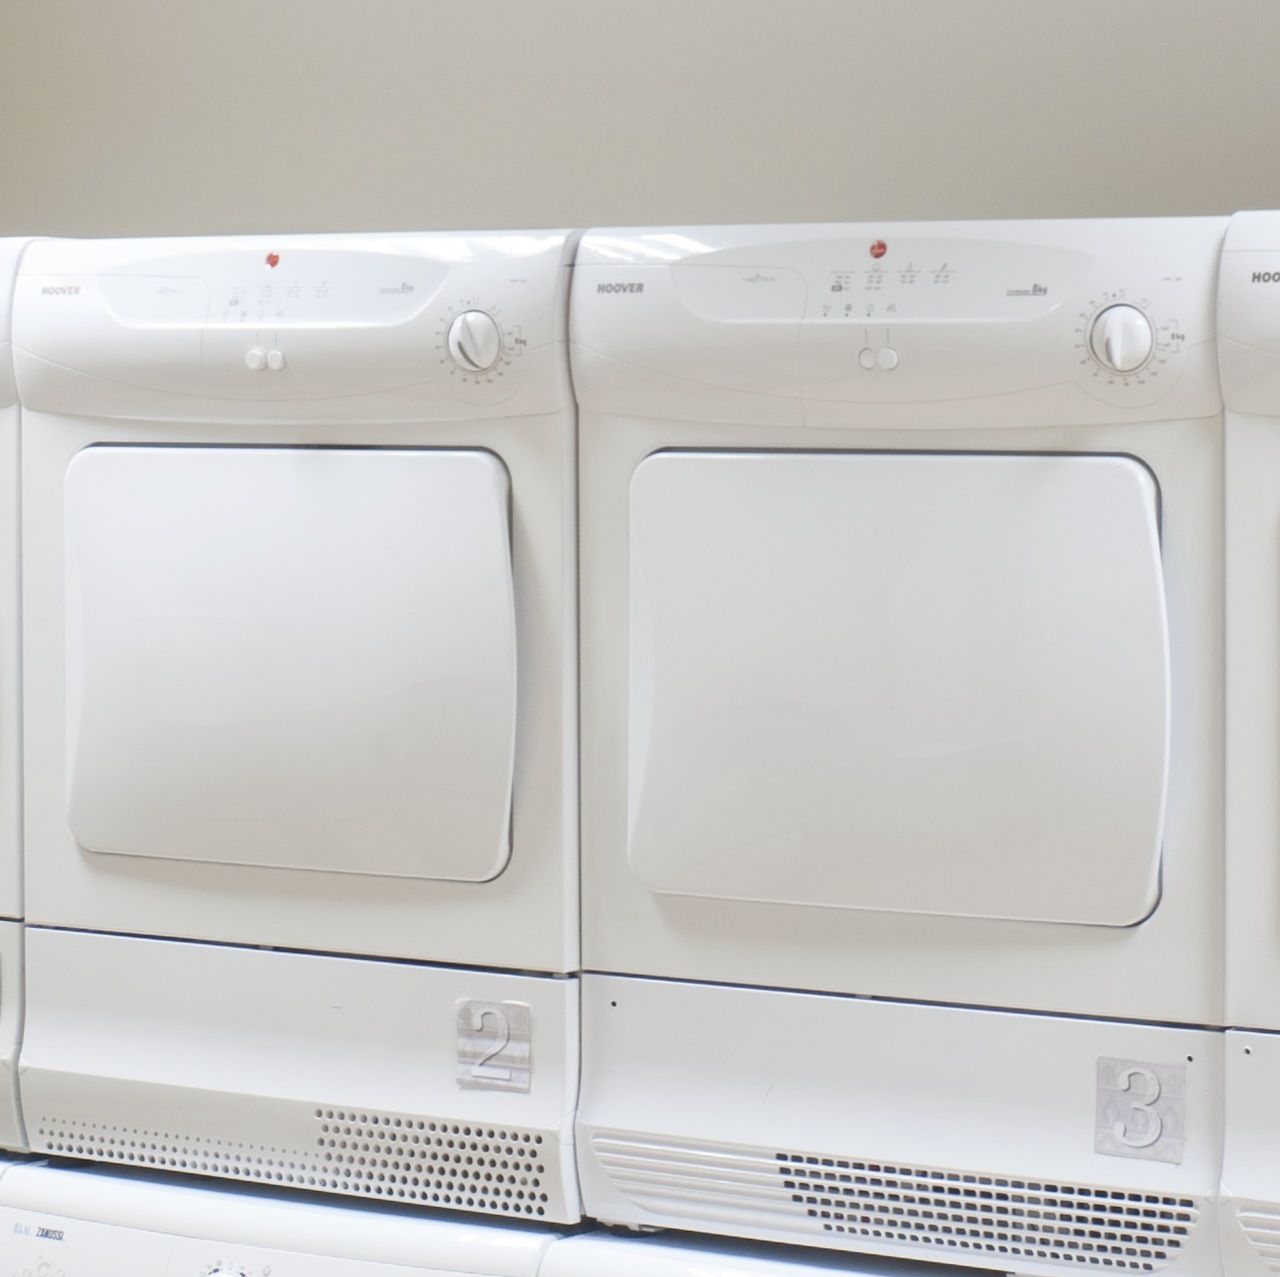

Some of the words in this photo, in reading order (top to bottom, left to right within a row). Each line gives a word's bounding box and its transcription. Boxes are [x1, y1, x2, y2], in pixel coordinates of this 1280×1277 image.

[41, 286, 81, 296] HOOVER
[596, 283, 644, 294] HOOVER
[471, 1007, 512, 1081] 2
[1113, 1067, 1163, 1149] 3
